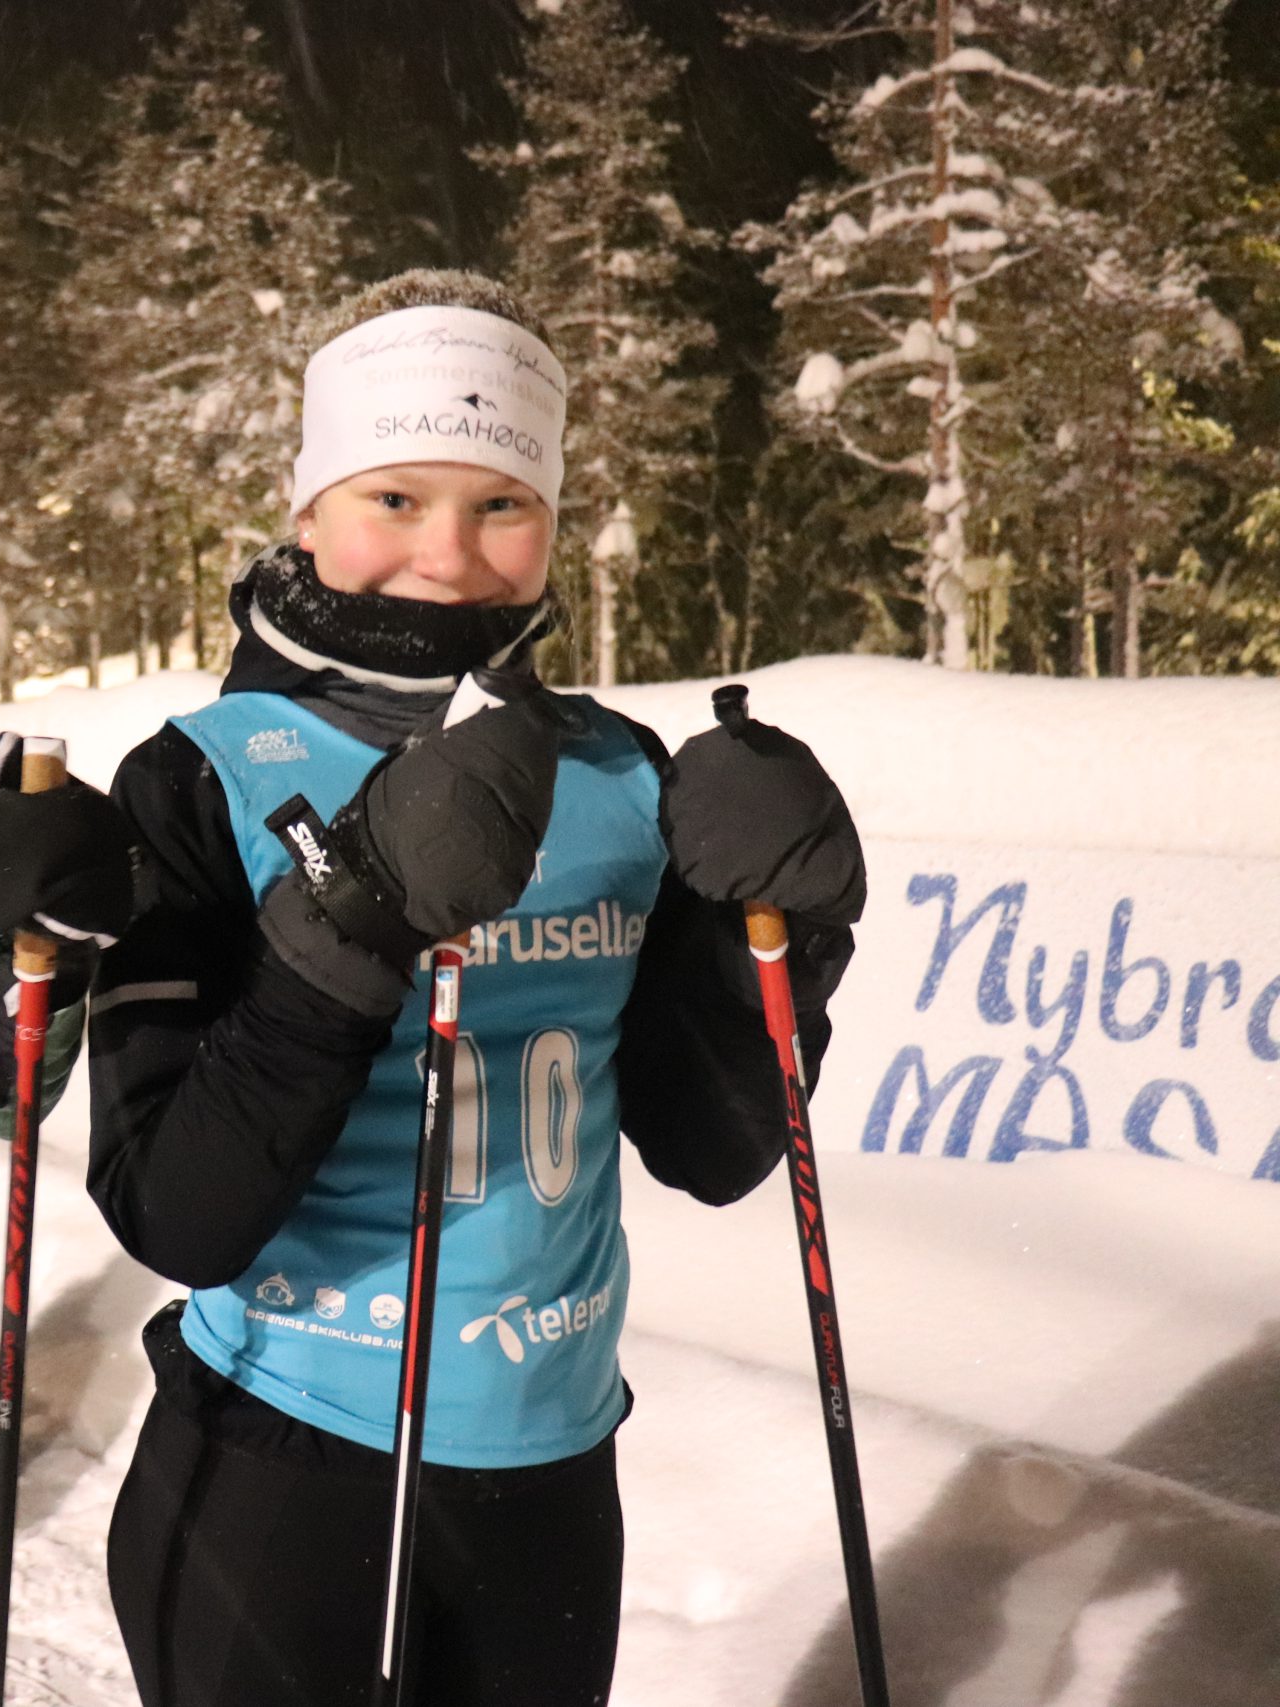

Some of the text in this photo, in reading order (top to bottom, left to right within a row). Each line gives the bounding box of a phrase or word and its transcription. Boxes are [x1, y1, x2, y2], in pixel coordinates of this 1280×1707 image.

[374, 412, 544, 465] SKAGAHØGDI
[420, 899, 647, 971] aruselle
[415, 1025, 584, 1207] 10
